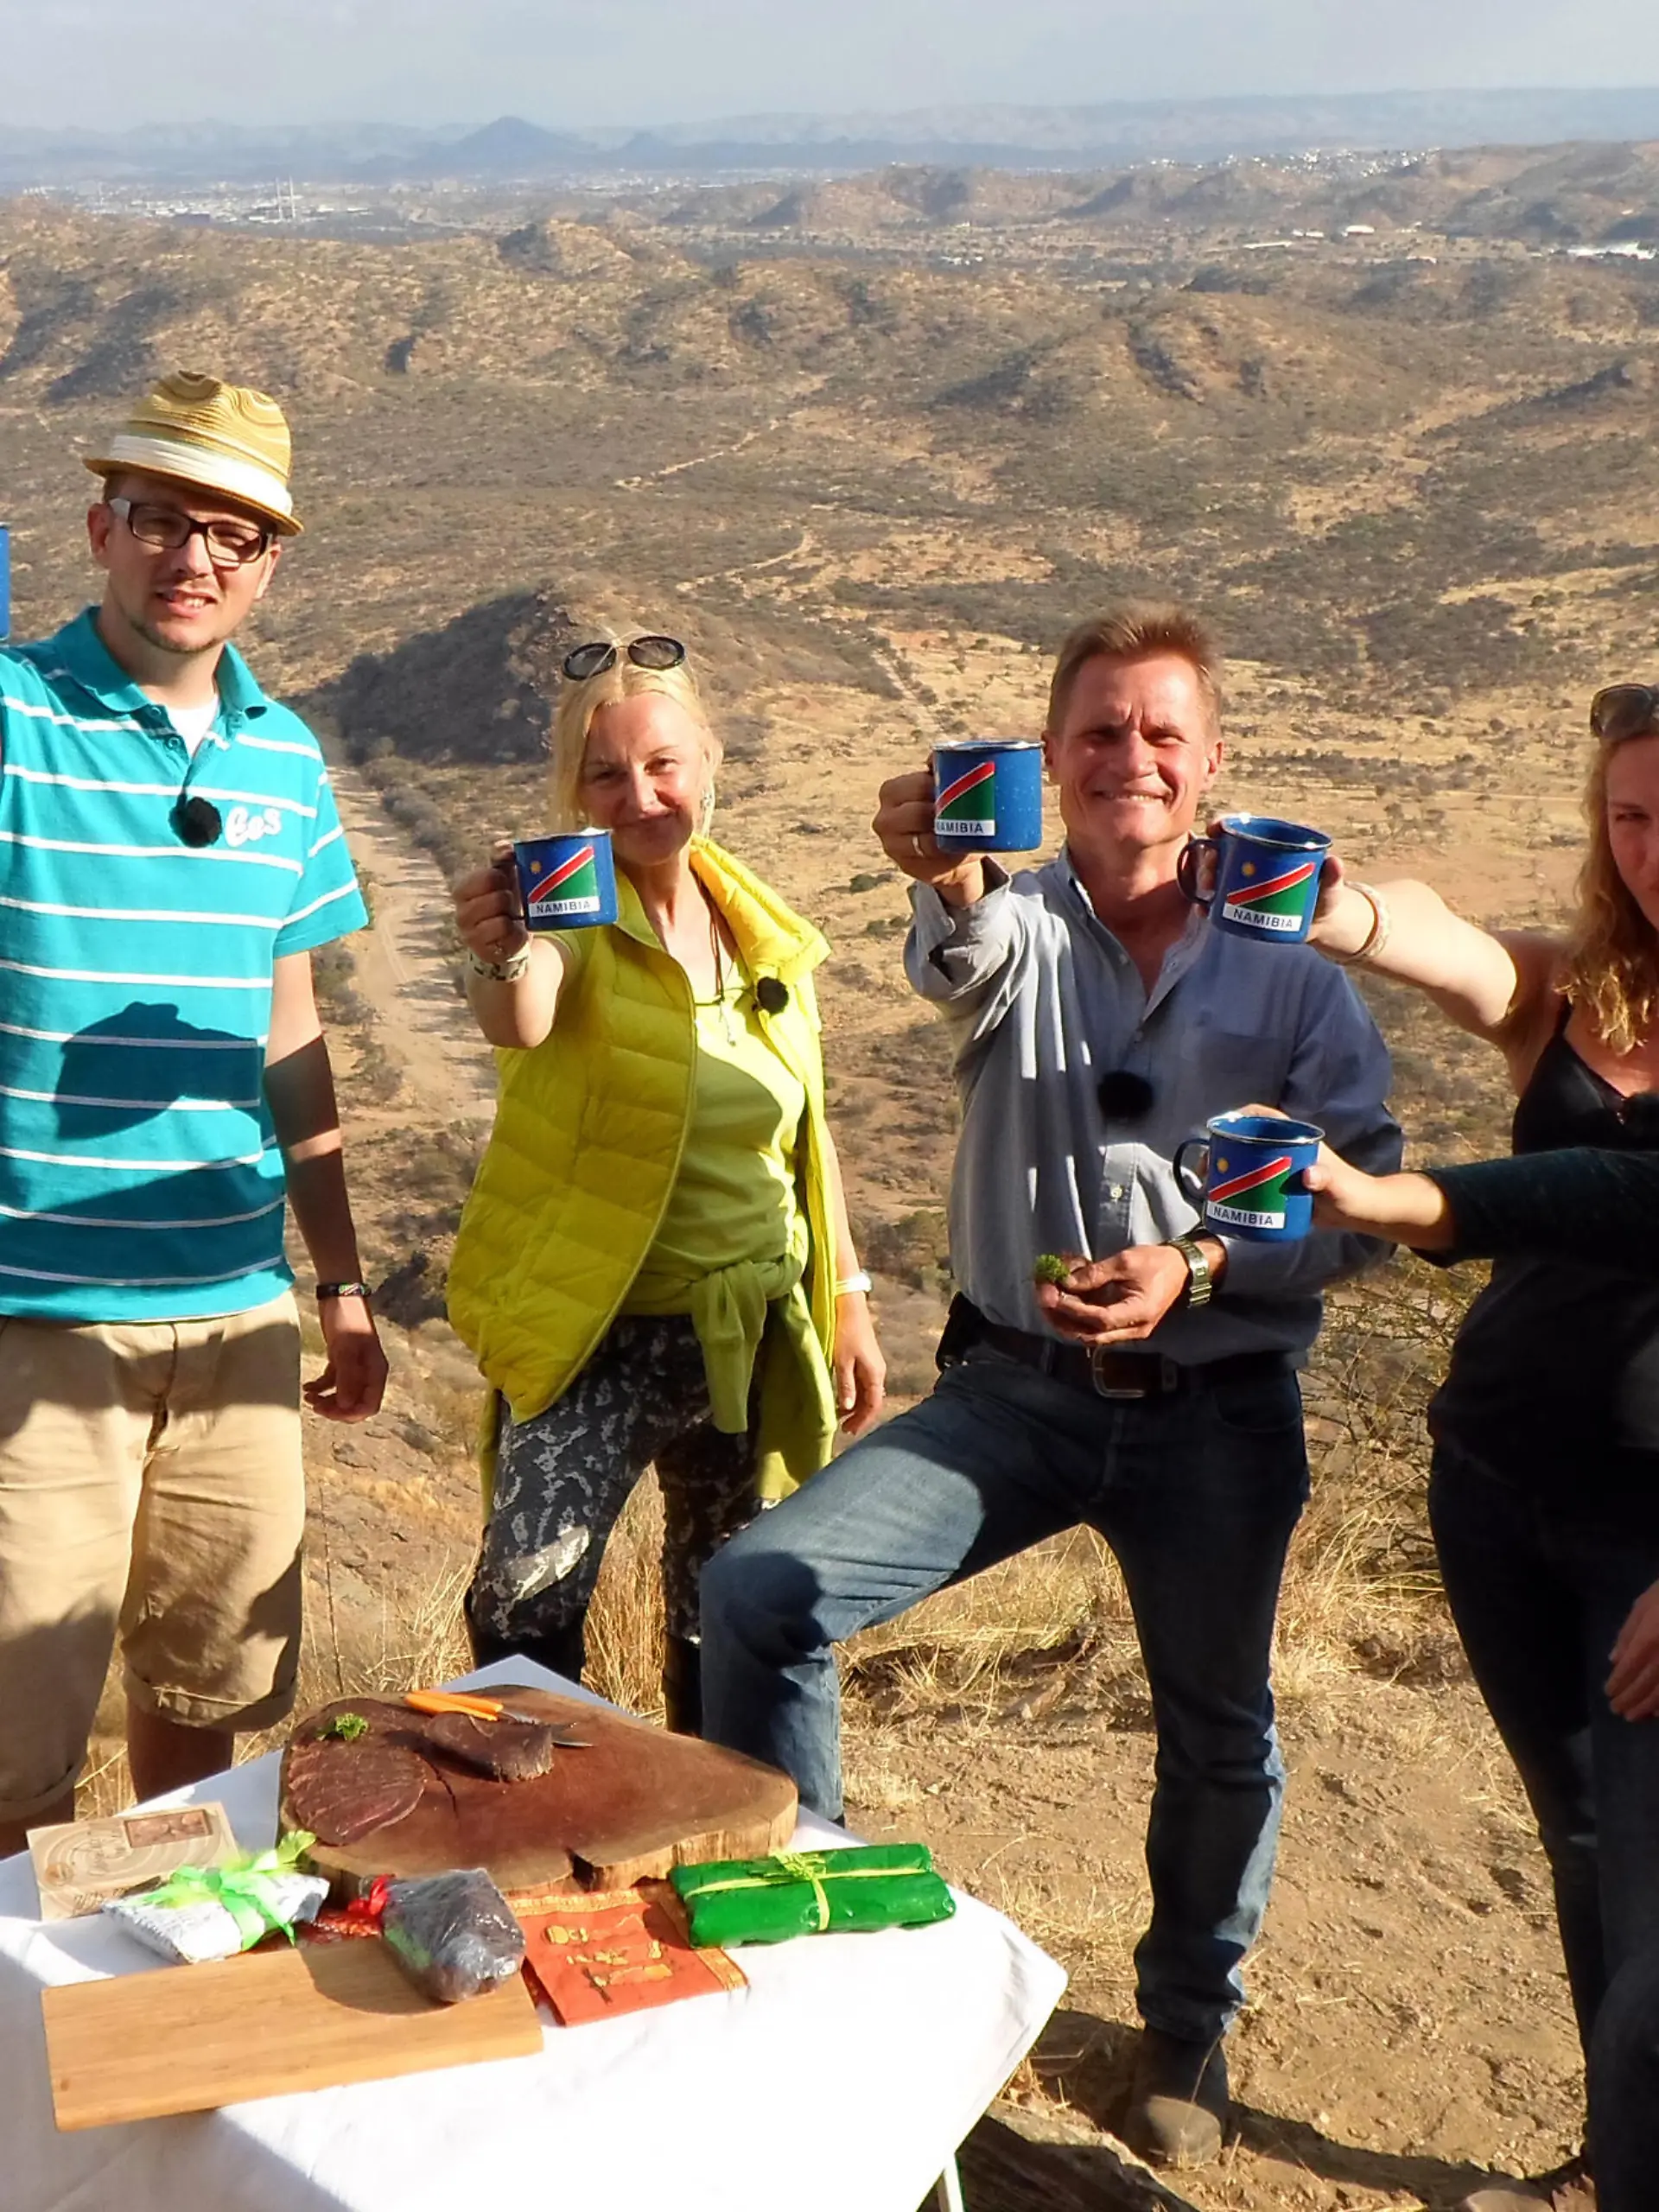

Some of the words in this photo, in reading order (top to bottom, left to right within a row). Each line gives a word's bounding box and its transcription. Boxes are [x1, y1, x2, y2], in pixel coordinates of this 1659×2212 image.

[536, 900, 590, 914] NAMIBIA
[1233, 908, 1293, 928] NAMIBIA
[1213, 1206, 1273, 1225] NAMIBIA
